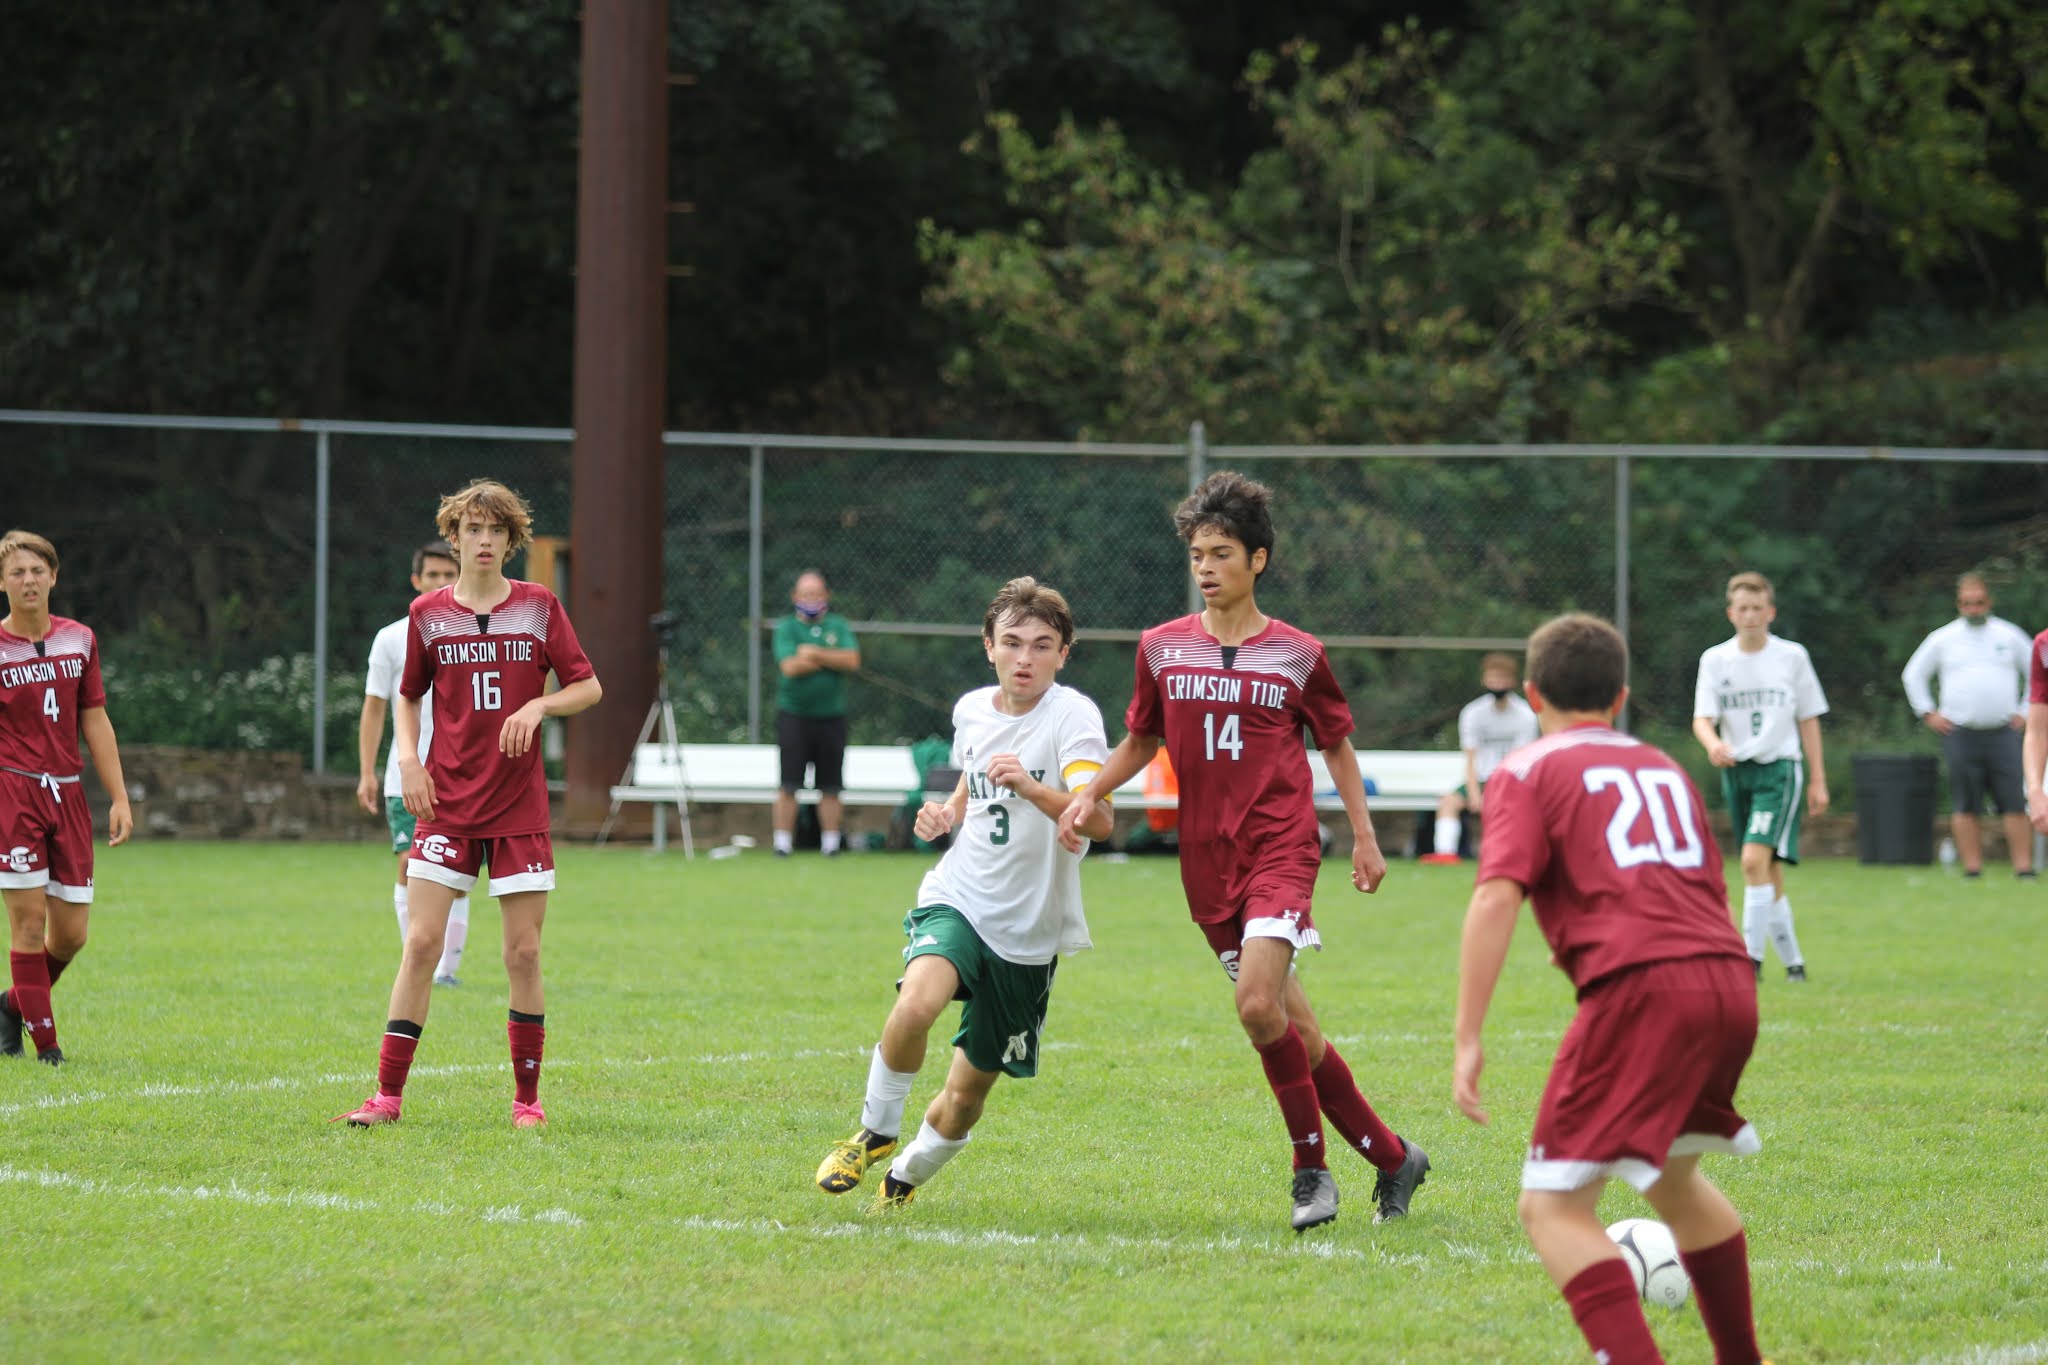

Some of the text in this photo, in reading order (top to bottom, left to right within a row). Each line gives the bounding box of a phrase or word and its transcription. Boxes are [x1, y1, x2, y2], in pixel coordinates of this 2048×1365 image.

[437, 640, 533, 665] CRIMSON TIDE
[1, 661, 57, 688] CRIMSON
[471, 671, 502, 711] 16
[1166, 674, 1288, 710] CRIMSON TIDE
[43, 687, 60, 723] 4
[1203, 713, 1244, 761] 14
[987, 804, 1010, 845] 3
[1582, 766, 1705, 869] 20
